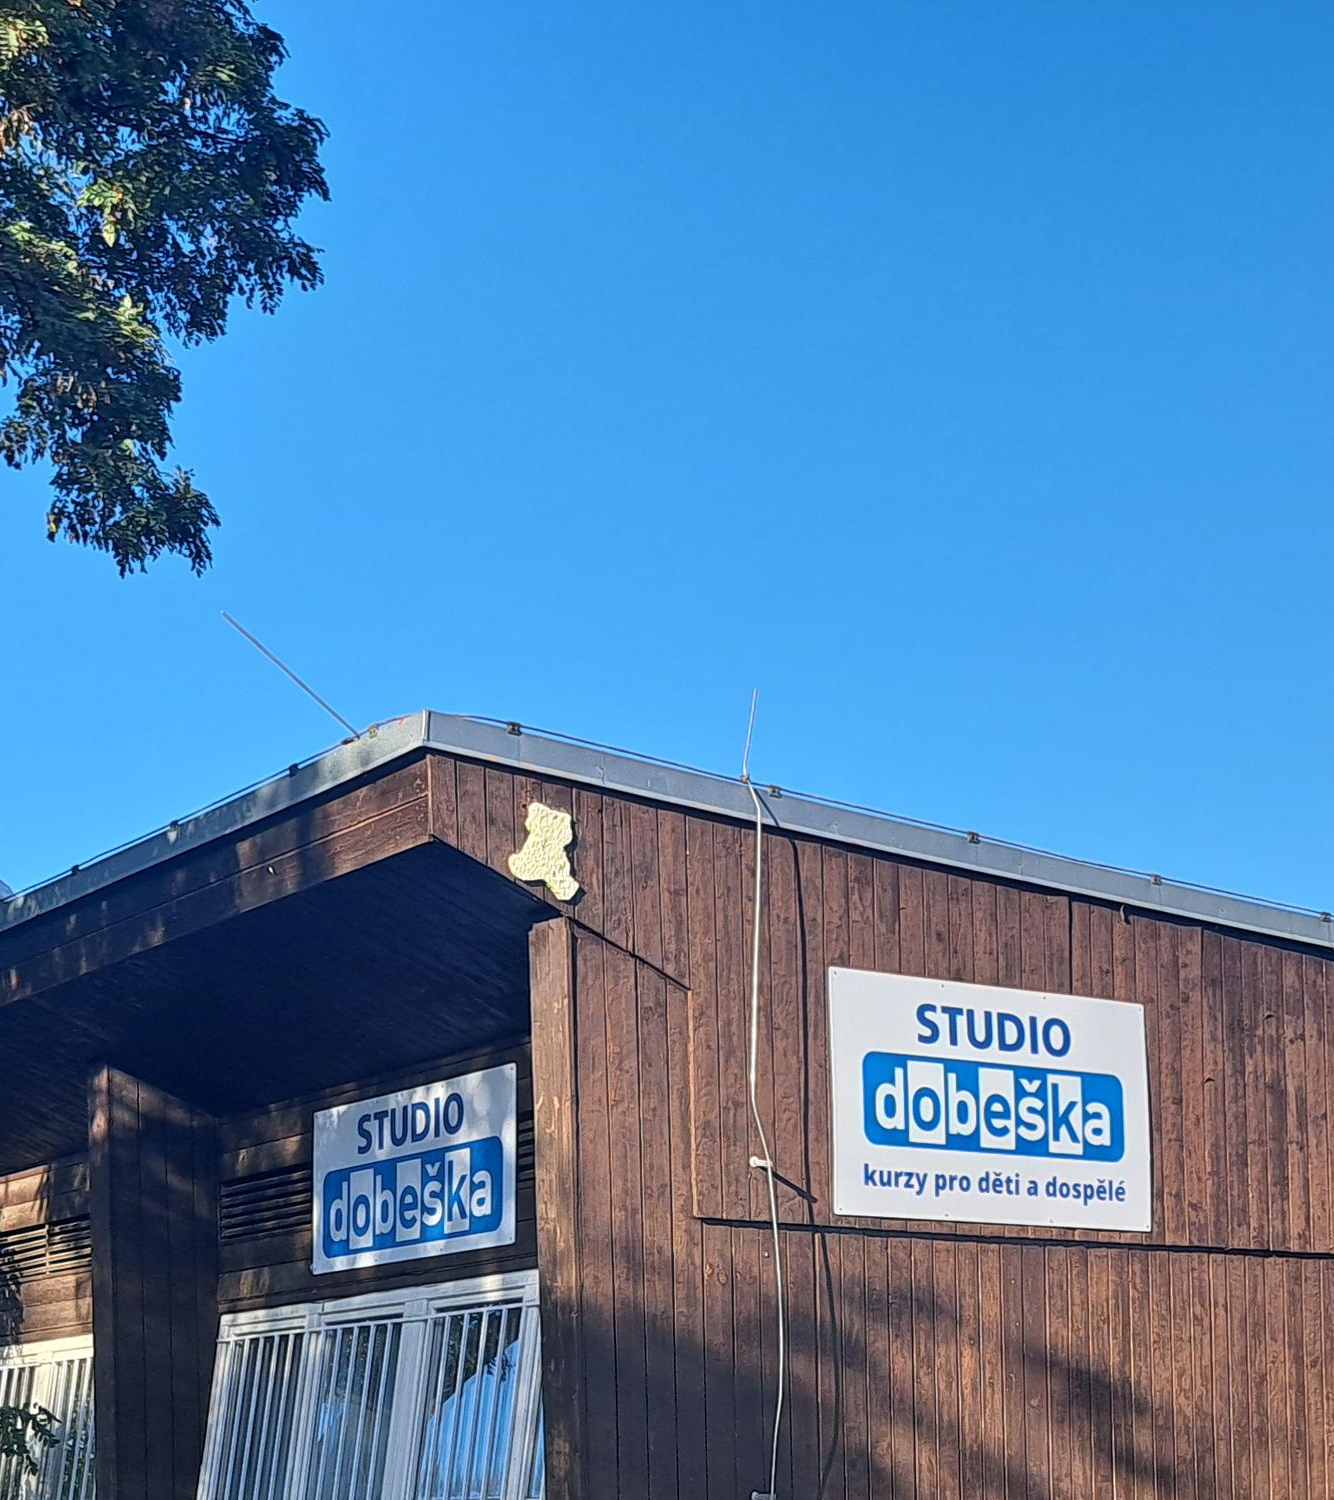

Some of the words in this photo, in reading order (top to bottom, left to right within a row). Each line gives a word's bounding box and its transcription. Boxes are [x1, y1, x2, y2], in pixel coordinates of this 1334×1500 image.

[916, 1003, 1071, 1057] STUDIO
[357, 1093, 464, 1155] STUDIO
[874, 1067, 1111, 1147] dobeška
[330, 1157, 492, 1242] dobeška
[864, 1163, 928, 1195] kurzy
[934, 1172, 971, 1196] pro
[978, 1171, 1020, 1195] děti
[1027, 1179, 1038, 1196] a
[1045, 1176, 1126, 1206] dospělé
